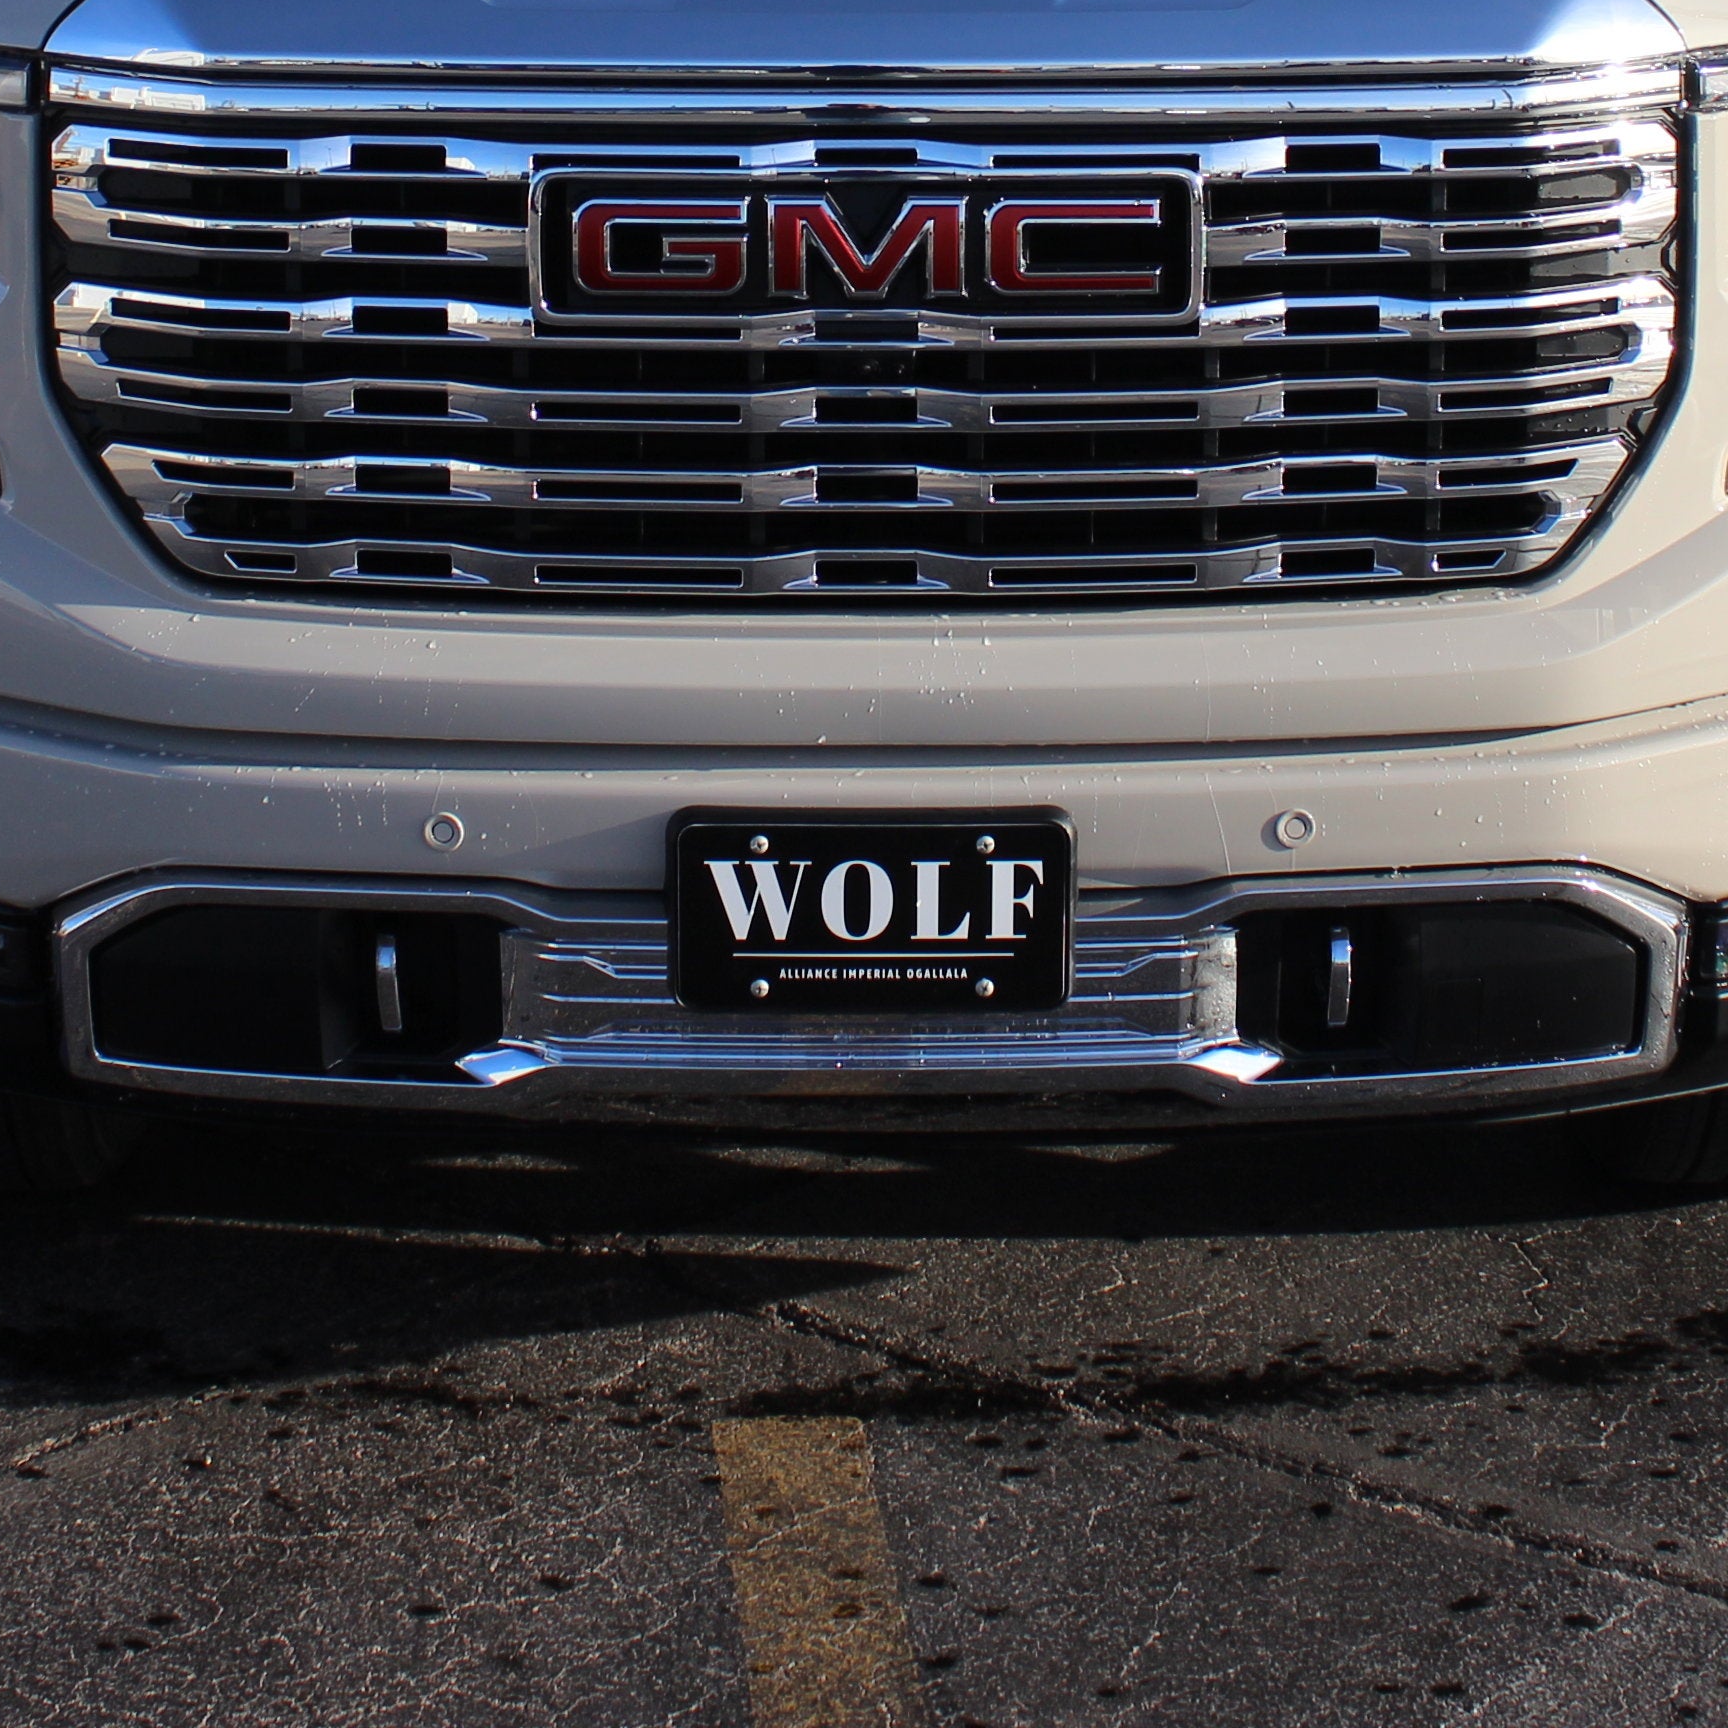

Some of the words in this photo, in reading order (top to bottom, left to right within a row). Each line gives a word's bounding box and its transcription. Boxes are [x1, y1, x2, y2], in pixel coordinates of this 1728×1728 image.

[573, 195, 1162, 300] GMC
[704, 860, 1045, 941] WOLF
[779, 968, 838, 979] ALLIANCE
[843, 968, 901, 979] IMPERIAL
[907, 968, 968, 979] OGALLALA
